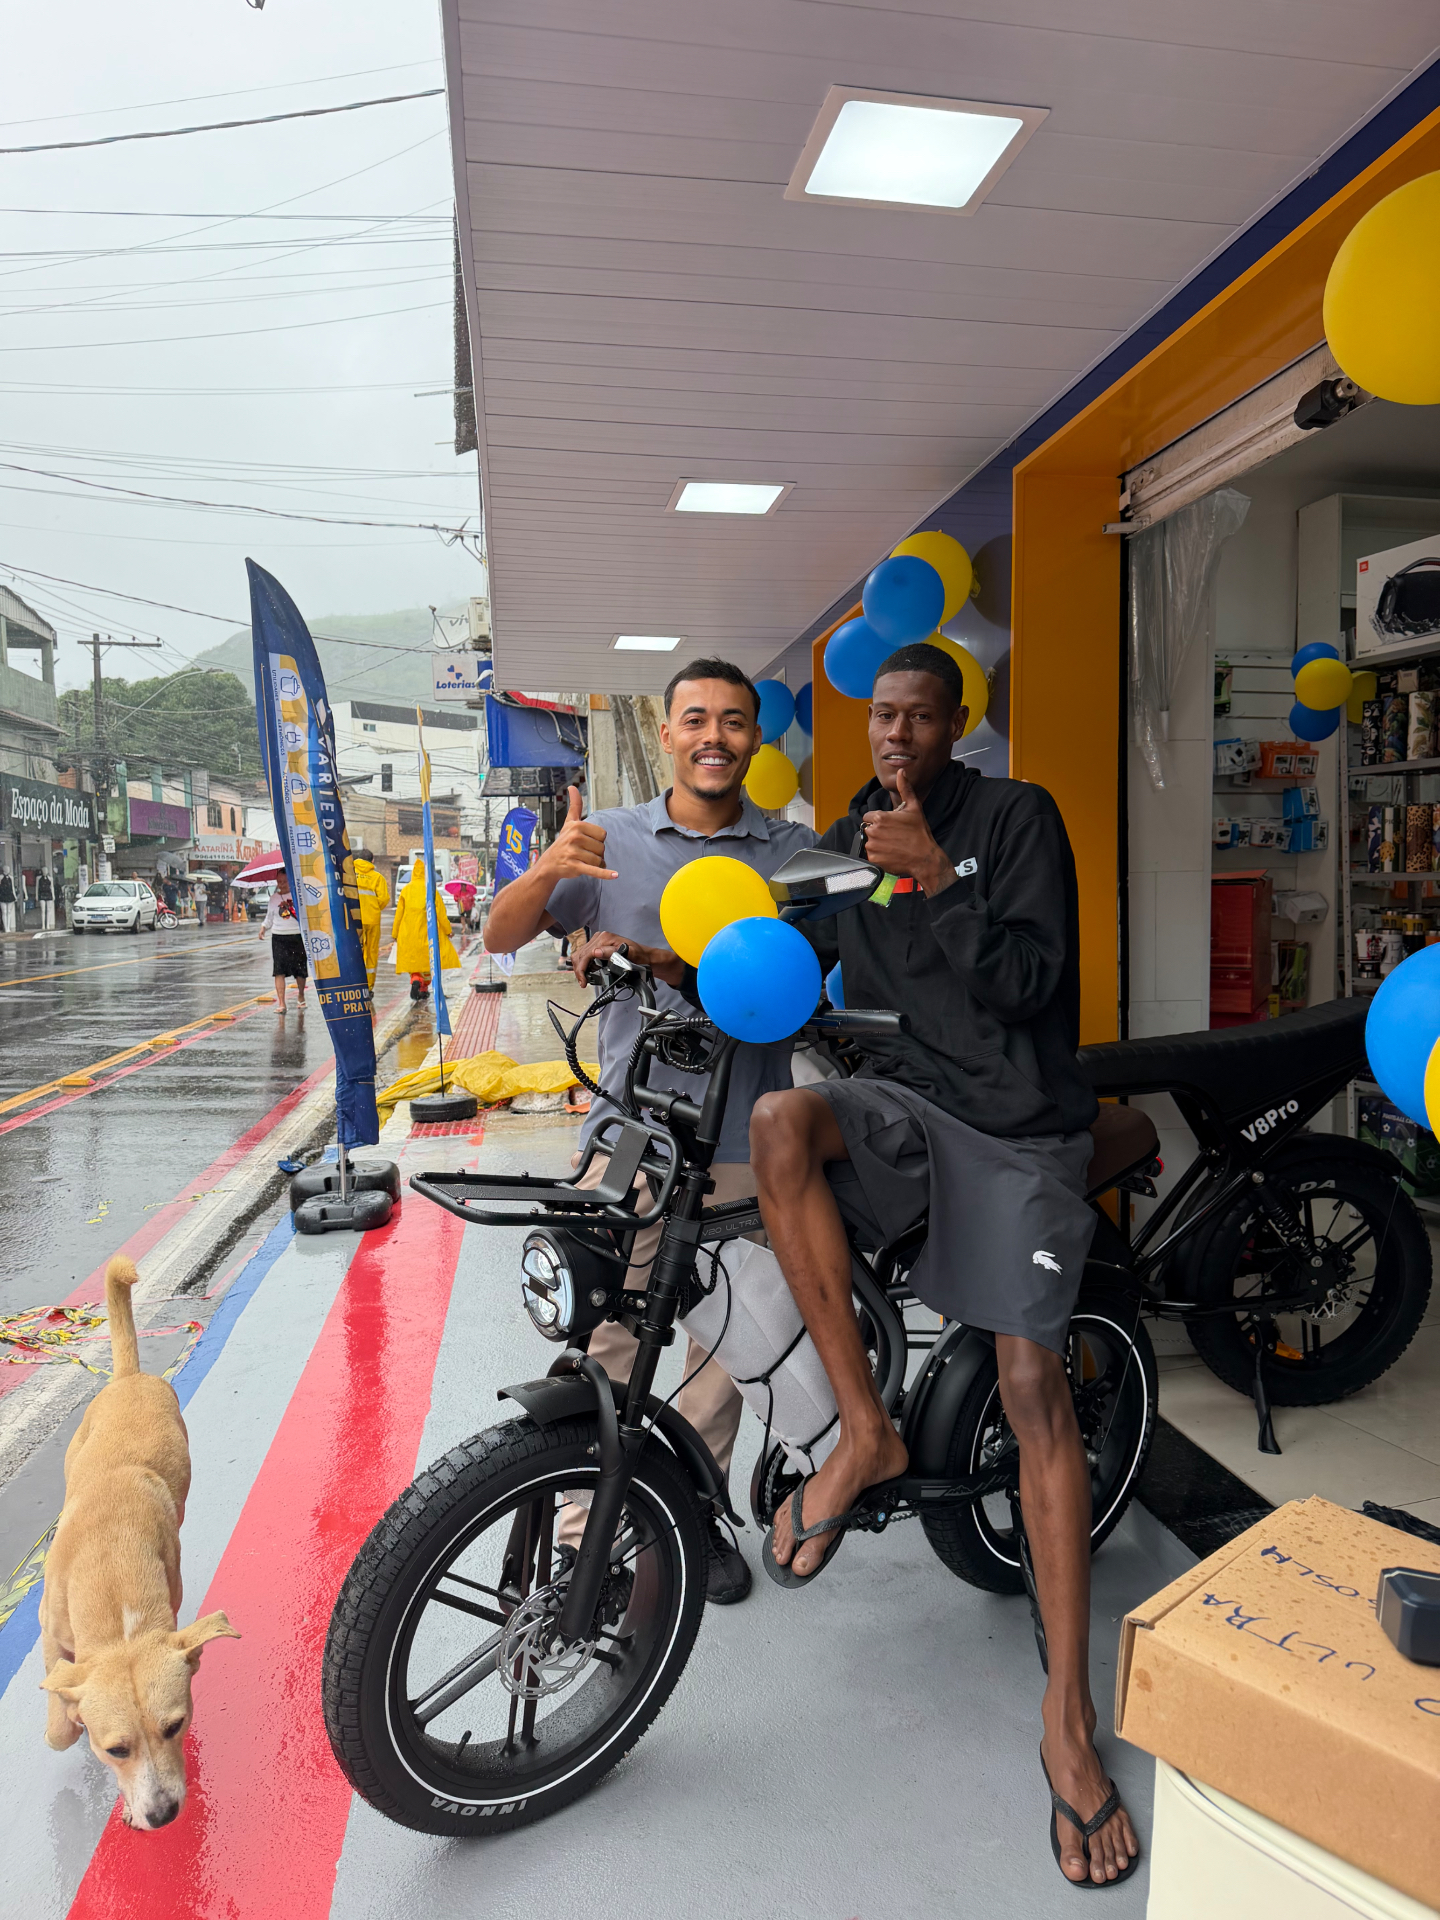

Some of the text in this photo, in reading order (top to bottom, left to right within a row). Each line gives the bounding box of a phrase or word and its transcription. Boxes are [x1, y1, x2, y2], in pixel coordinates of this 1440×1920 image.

[436, 680, 476, 690] Loterias
[11, 788, 90, 829] Espaço da Moda
[318, 737, 344, 897] VARIEDADES
[505, 824, 523, 855] 15
[319, 993, 333, 1005] DE
[334, 989, 361, 1002] TUDO
[343, 1002, 364, 1014] PRA
[1240, 1099, 1299, 1143] V8Pro
[725, 1218, 759, 1231] ULTRA
[1202, 1592, 1376, 1681] ULTRA
[430, 1796, 528, 1817] INNOVA
